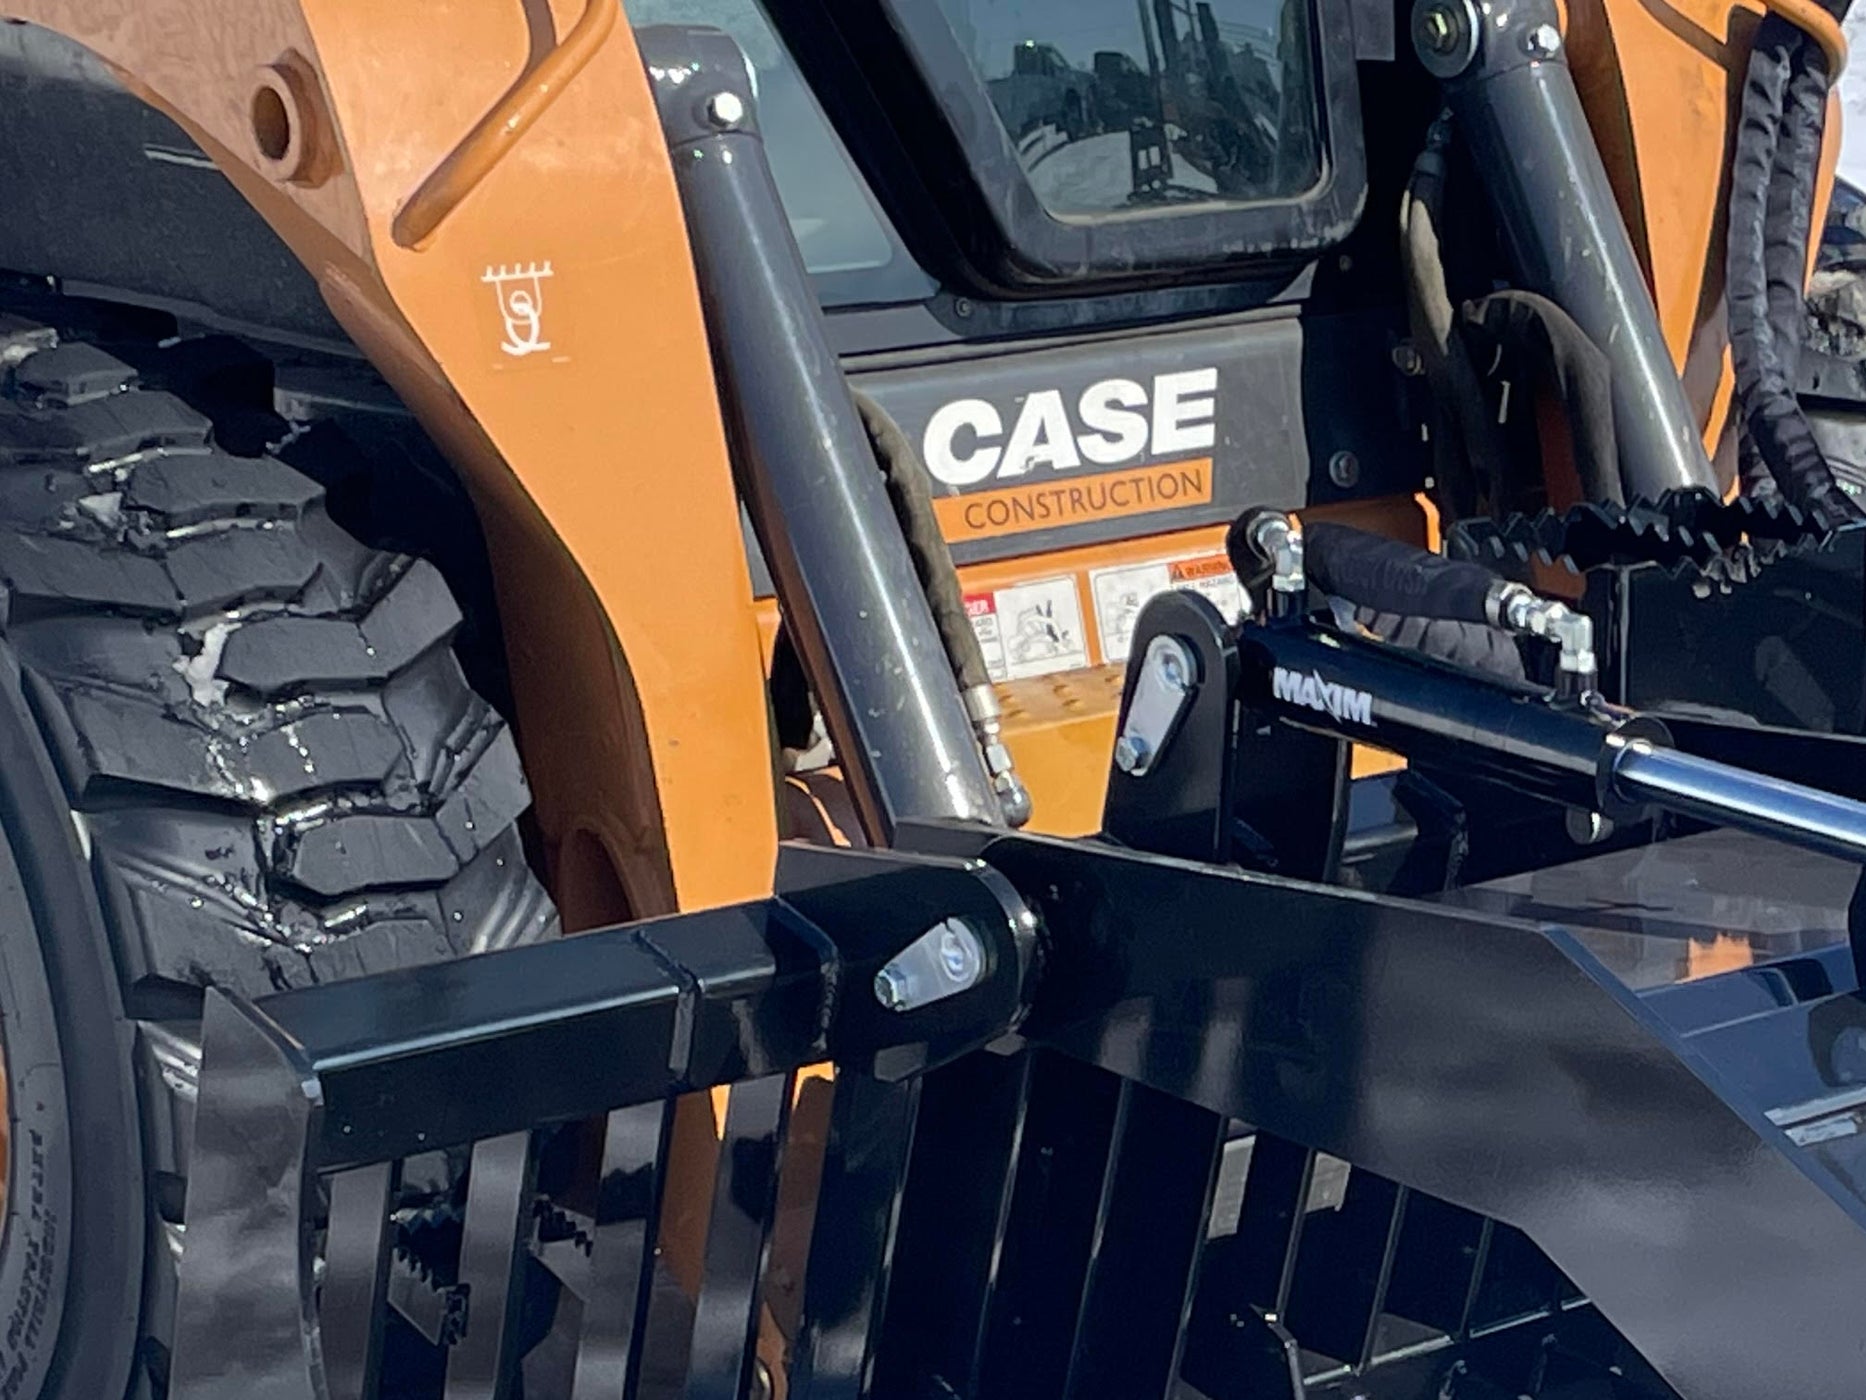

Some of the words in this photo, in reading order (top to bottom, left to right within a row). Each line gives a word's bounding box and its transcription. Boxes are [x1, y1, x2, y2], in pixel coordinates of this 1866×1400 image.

[923, 368, 1217, 485] CASE
[965, 469, 1203, 529] CONSTRUCTION
[1273, 667, 1373, 725] MAXIM
